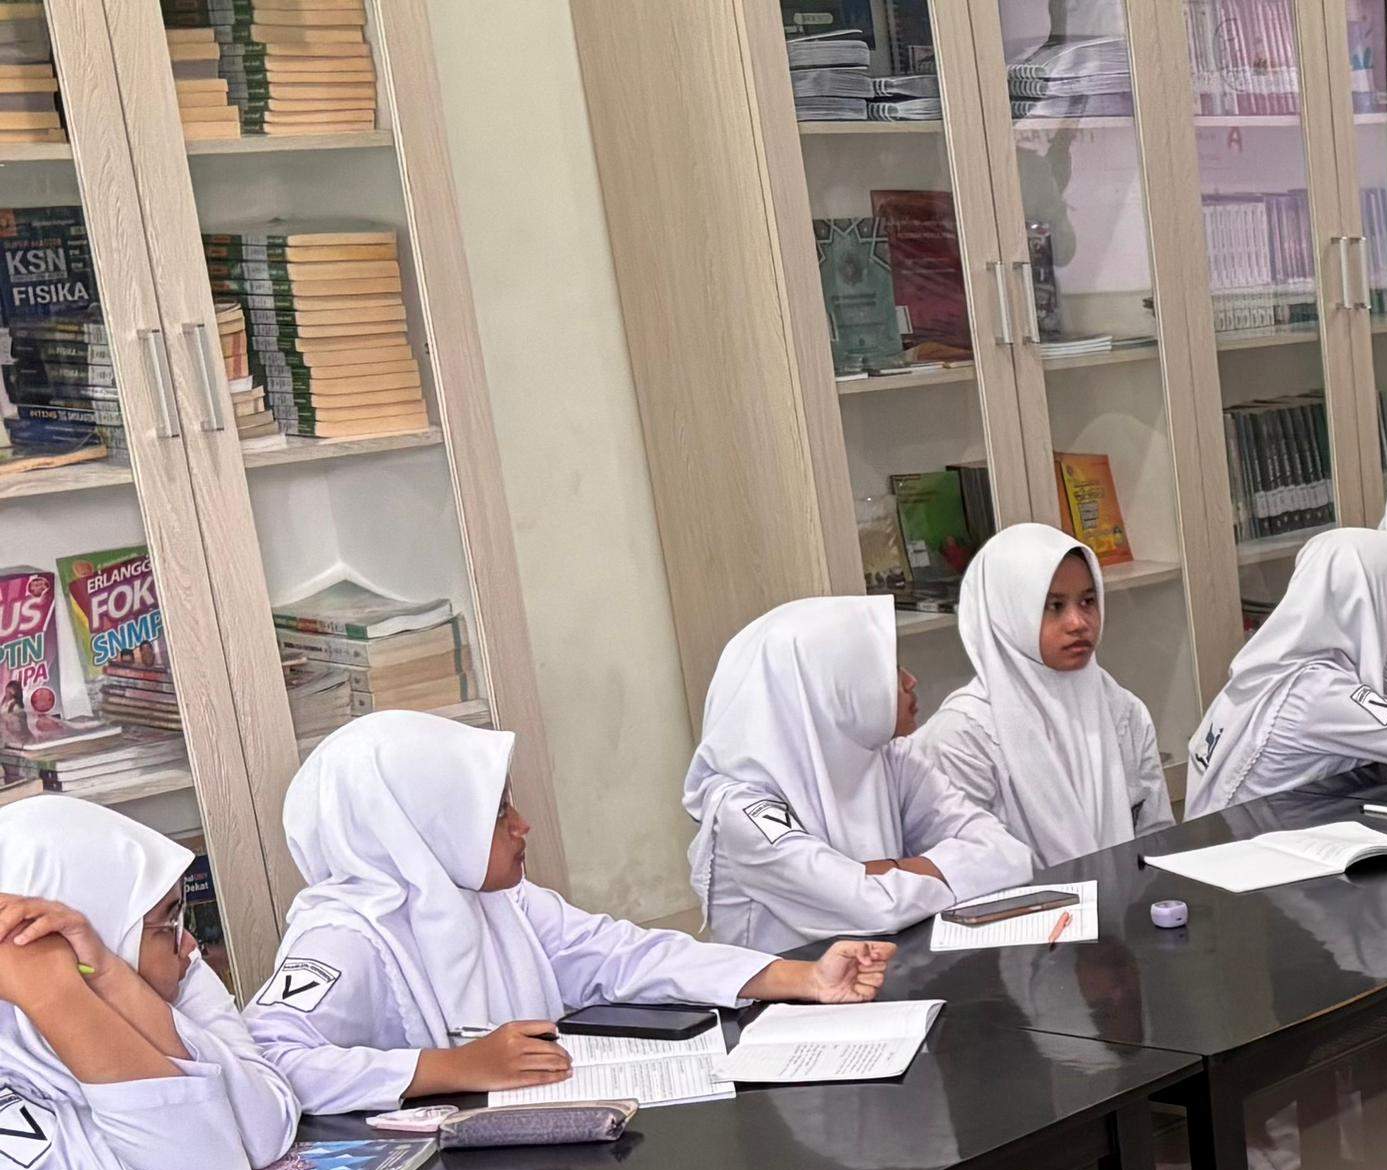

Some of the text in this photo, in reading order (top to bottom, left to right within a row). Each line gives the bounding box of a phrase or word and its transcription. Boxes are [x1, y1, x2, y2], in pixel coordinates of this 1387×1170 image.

[5, 247, 68, 275] KSN
[12, 281, 89, 306] FISIKA
[18, 662, 49, 688] IPA
